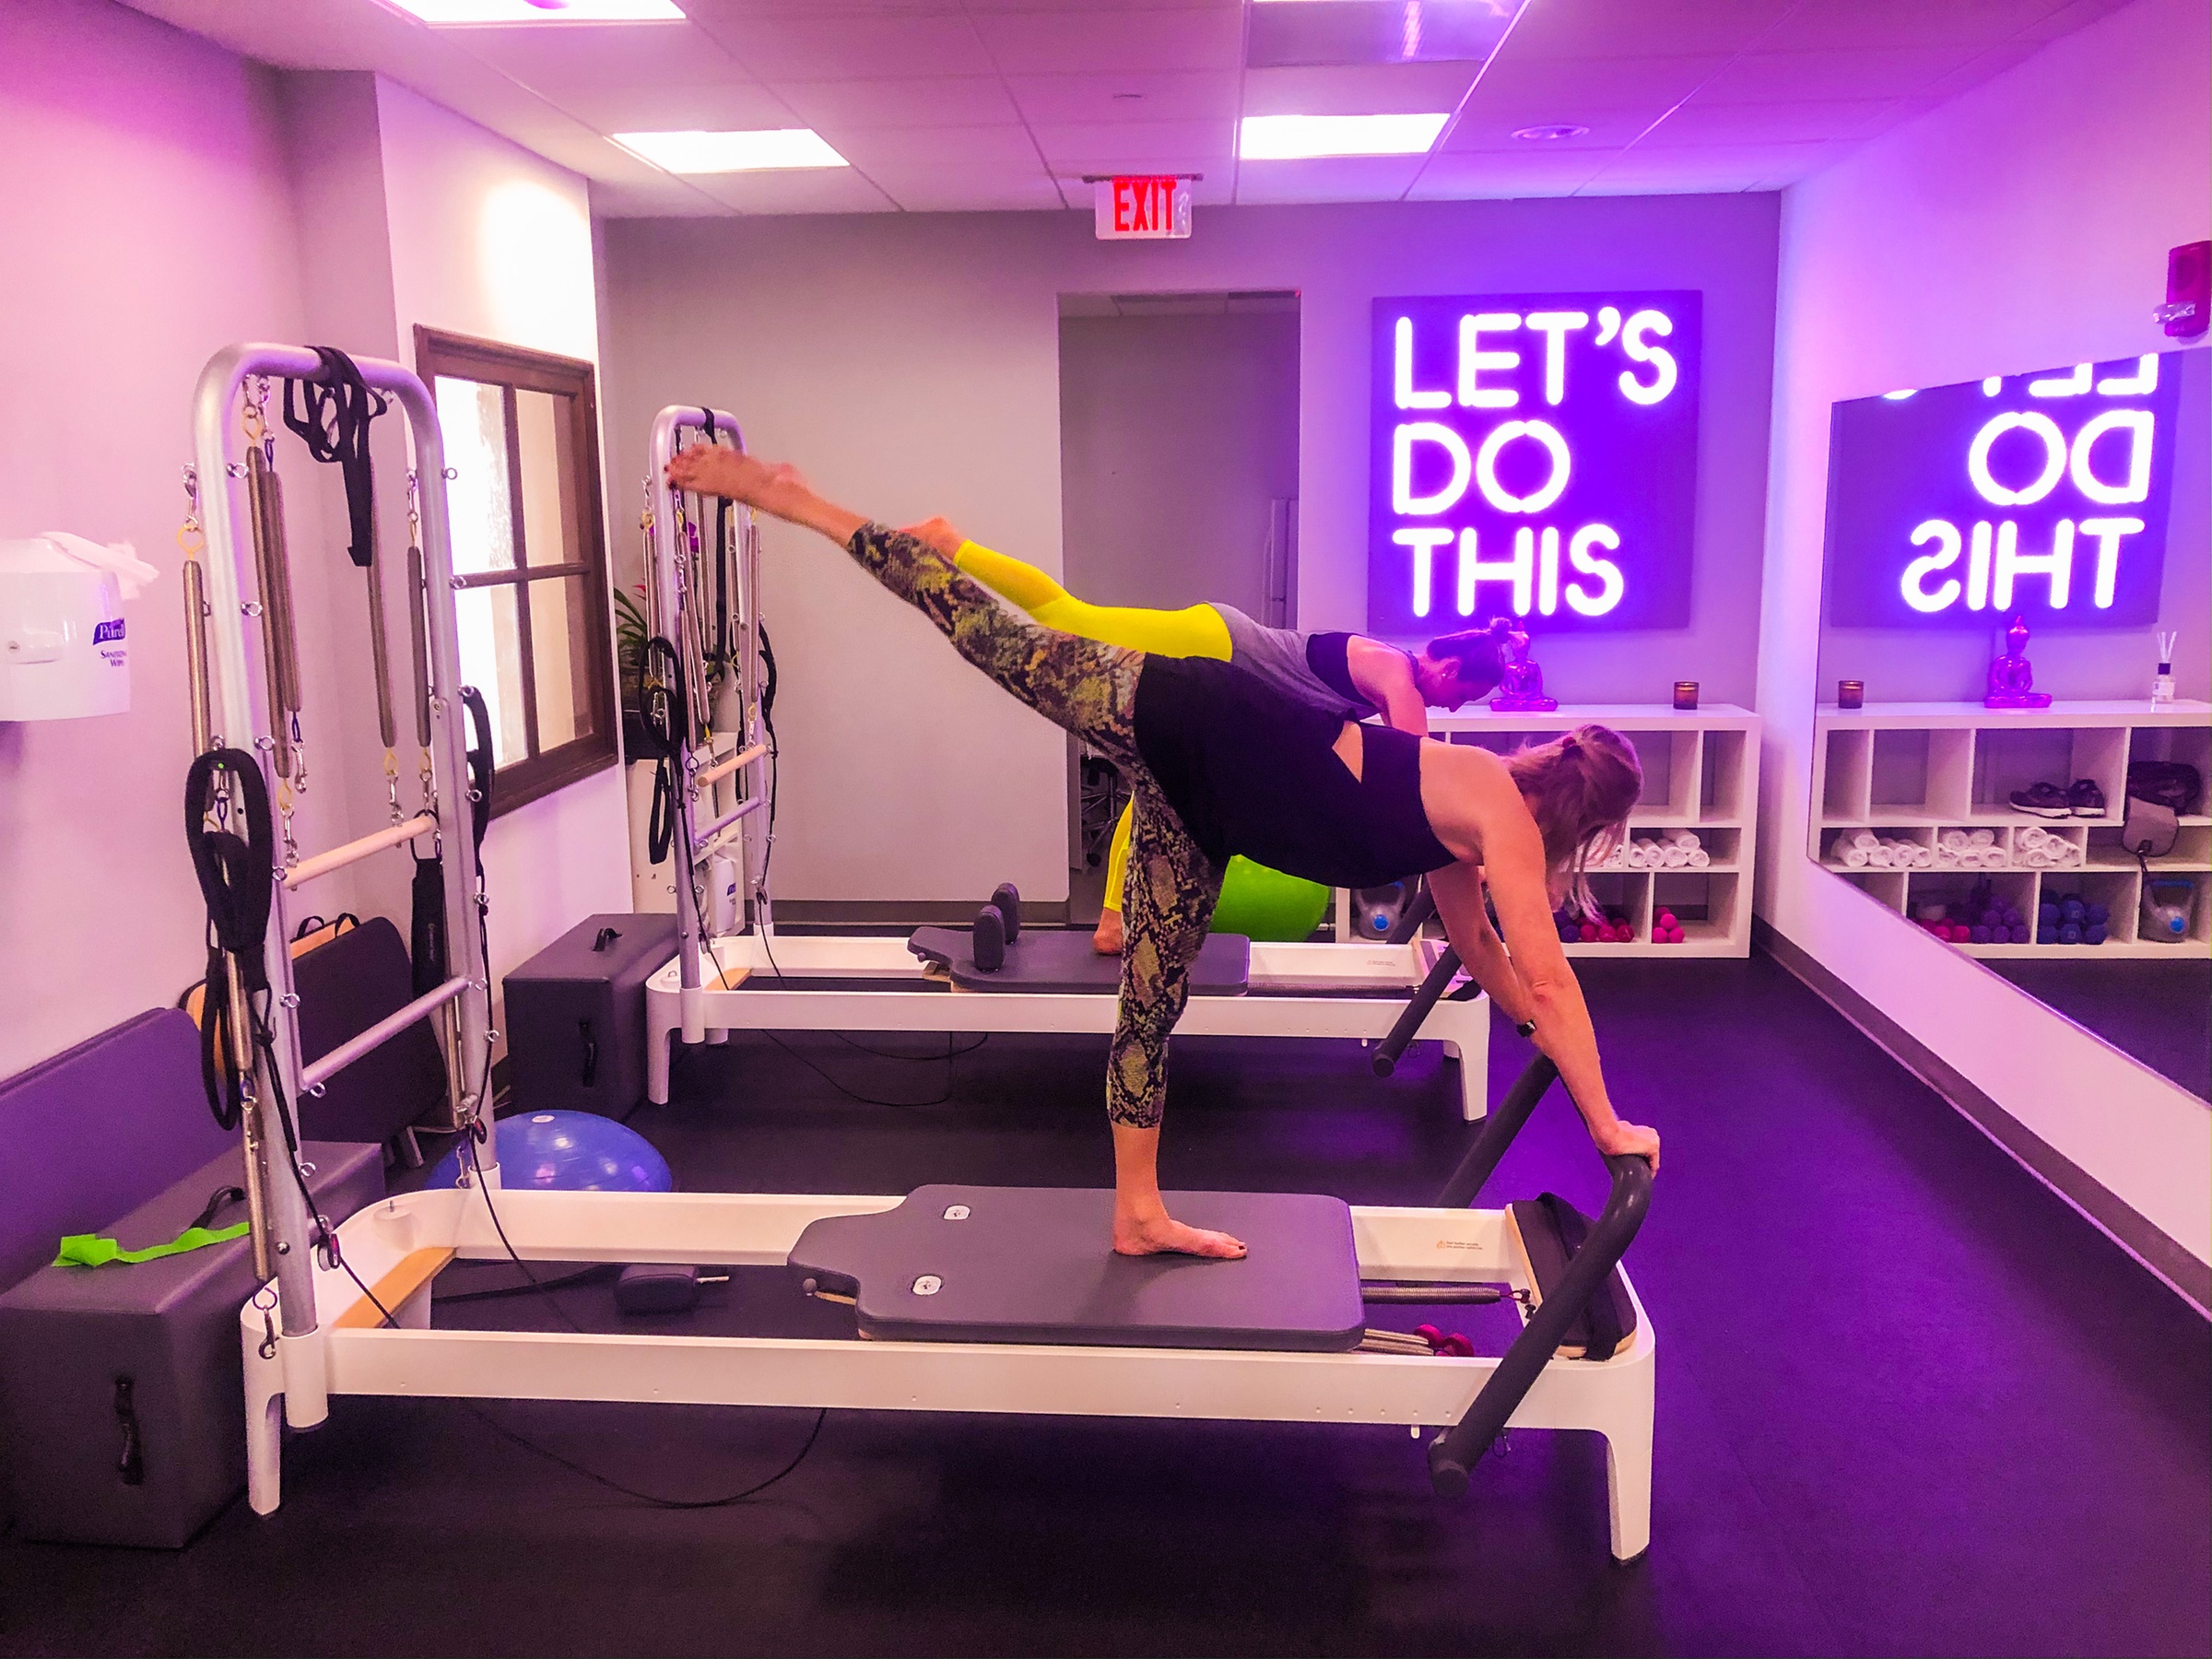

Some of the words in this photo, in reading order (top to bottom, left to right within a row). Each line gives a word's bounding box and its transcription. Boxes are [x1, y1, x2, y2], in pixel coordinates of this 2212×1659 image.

[1112, 181, 1177, 232] EXIT
[1394, 306, 1677, 409] LET'S
[1393, 419, 1571, 515] DO
[1392, 524, 1624, 618] THIS
